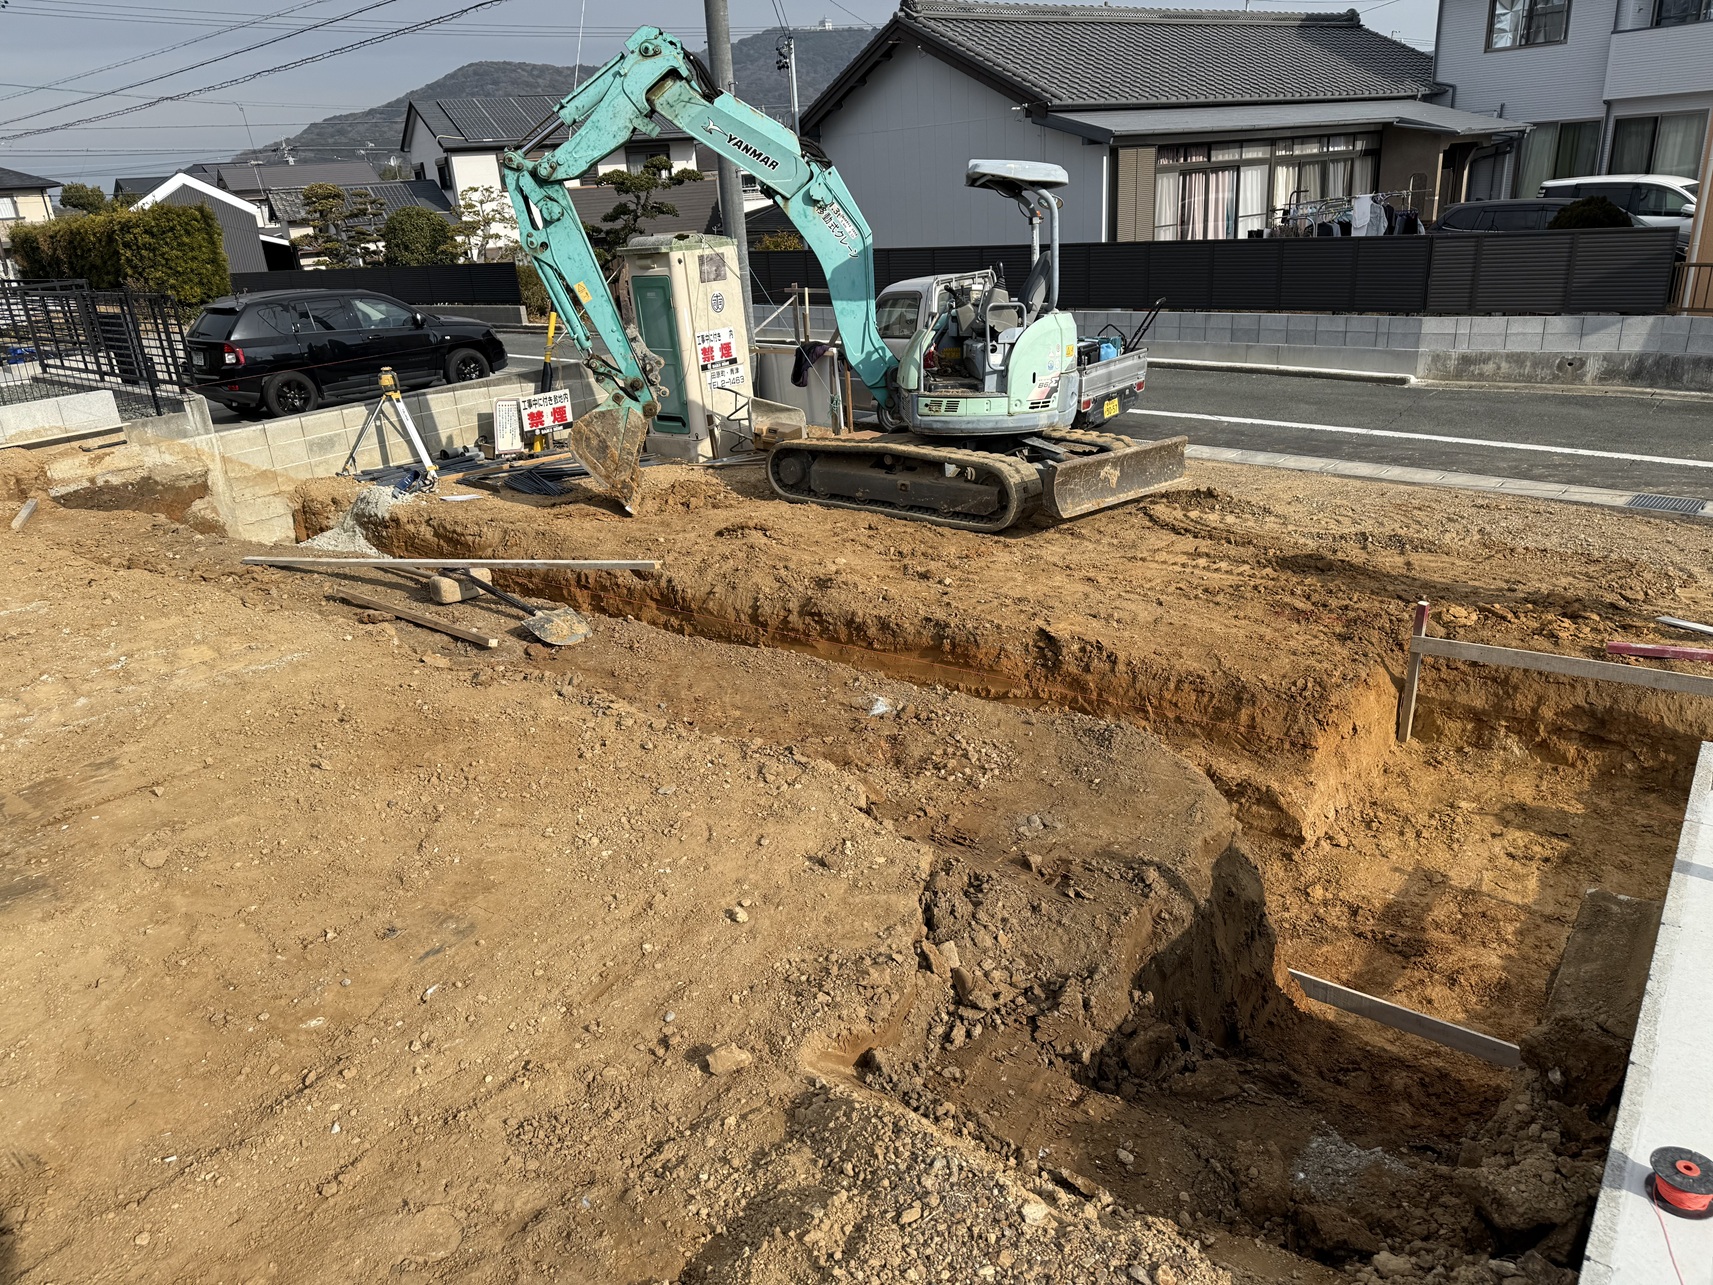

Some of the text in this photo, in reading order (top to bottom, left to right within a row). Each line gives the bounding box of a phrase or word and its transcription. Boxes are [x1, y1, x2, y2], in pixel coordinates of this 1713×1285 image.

[727, 133, 780, 171] YANMAR
[522, 392, 569, 411] 工事中に付き敷地内
[527, 405, 568, 429] 禁煙
